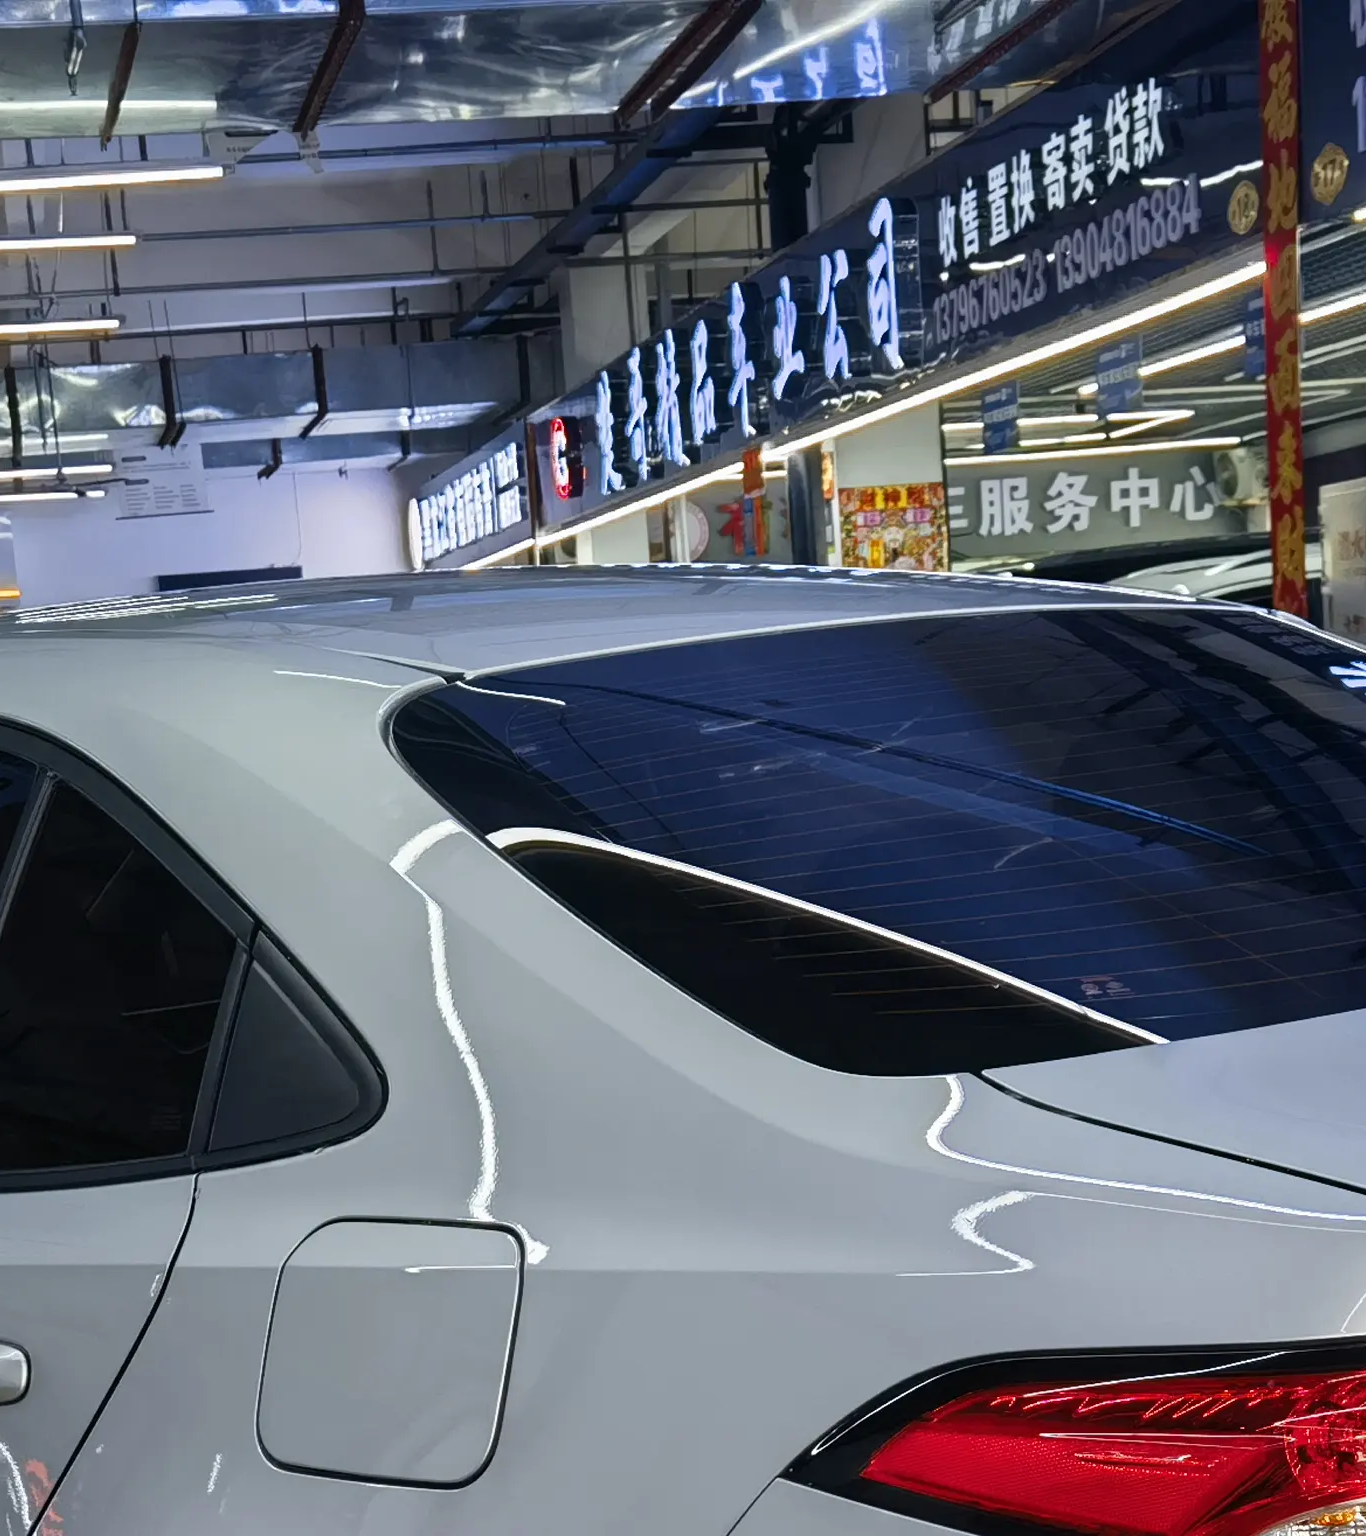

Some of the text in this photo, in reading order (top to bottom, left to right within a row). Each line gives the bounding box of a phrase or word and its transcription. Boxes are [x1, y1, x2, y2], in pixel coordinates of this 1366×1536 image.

[938, 77, 1165, 267] 收售 置换 寄卖 贷款
